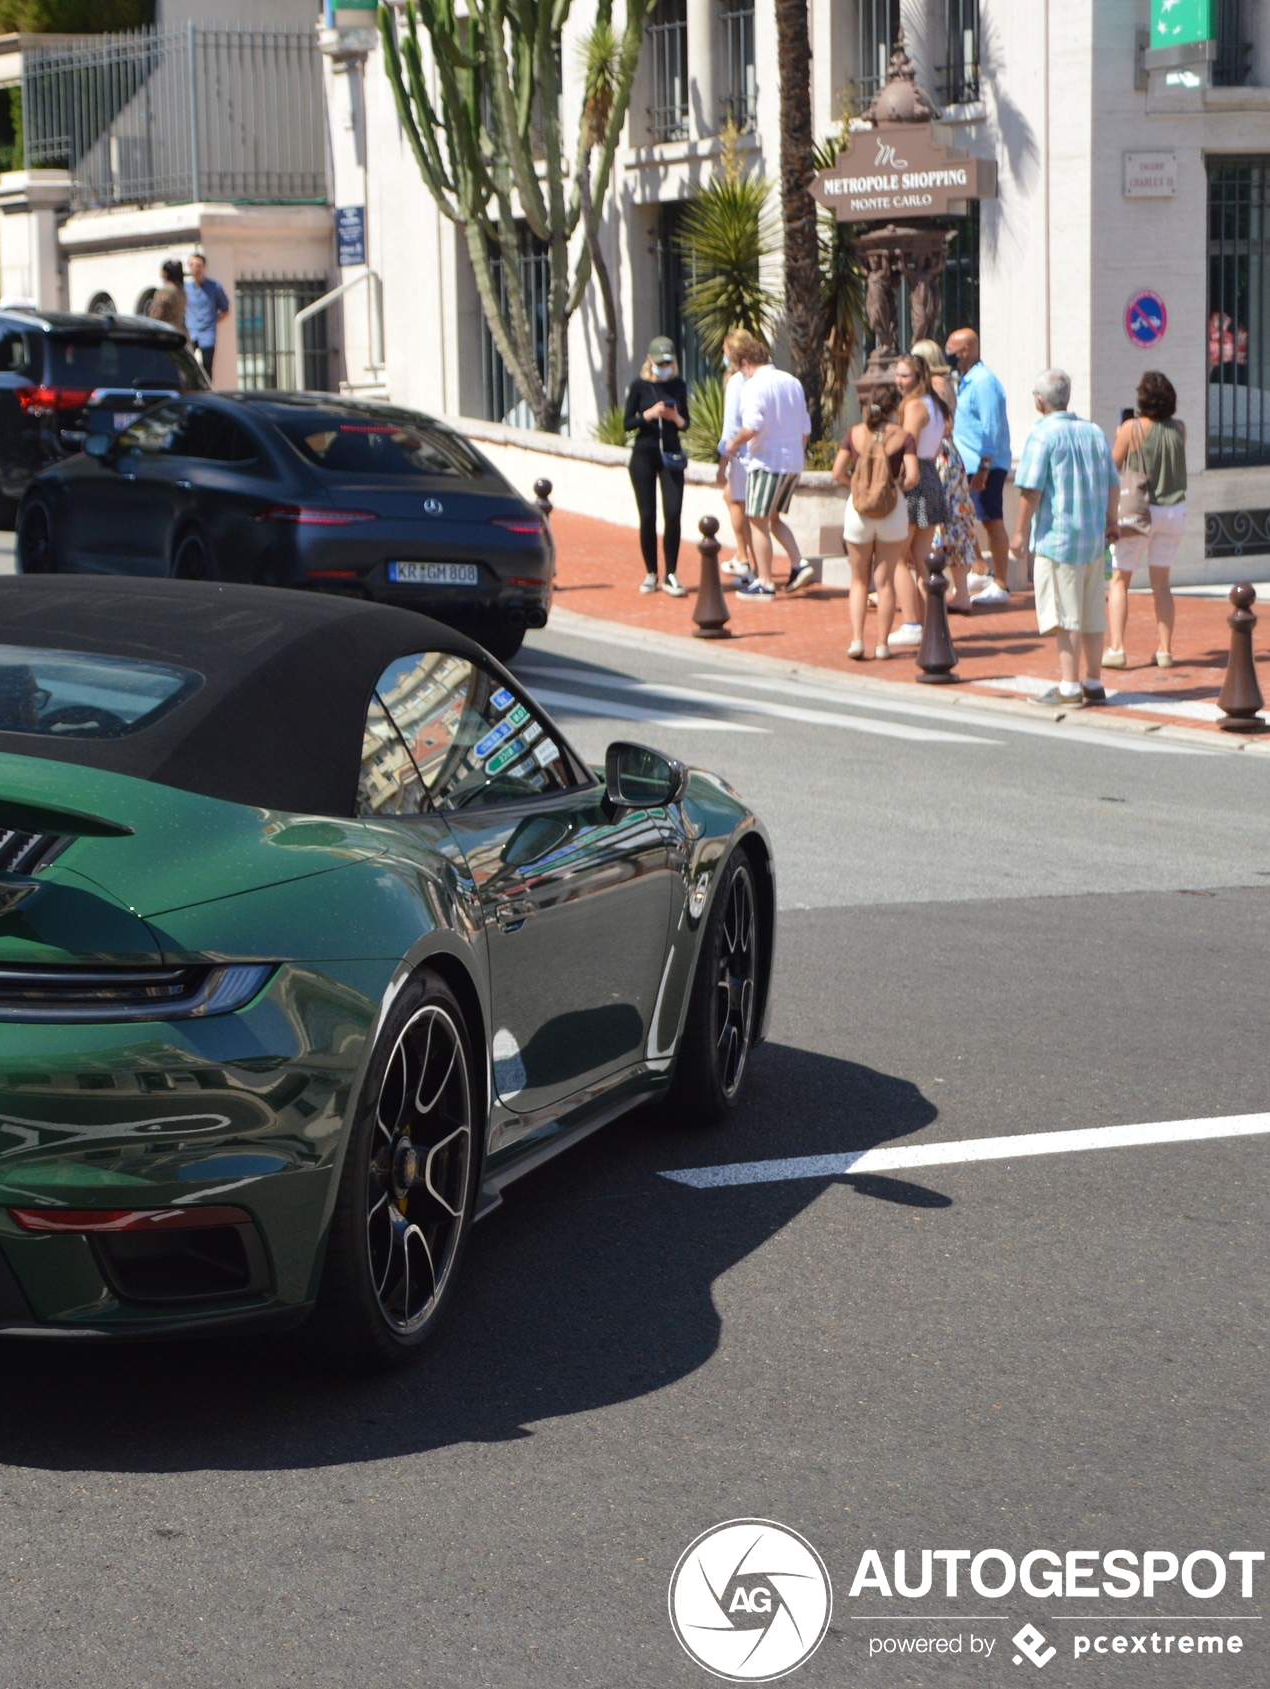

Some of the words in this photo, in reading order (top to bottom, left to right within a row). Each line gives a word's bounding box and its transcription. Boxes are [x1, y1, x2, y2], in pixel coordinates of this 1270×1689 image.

[823, 174, 899, 196] METROPOLE
[901, 168, 967, 190] SHOPPING
[850, 196, 891, 211] MONTE
[892, 193, 932, 208] CARLO
[397, 561, 417, 578] KR
[427, 563, 446, 580] GM
[449, 564, 475, 581] 808
